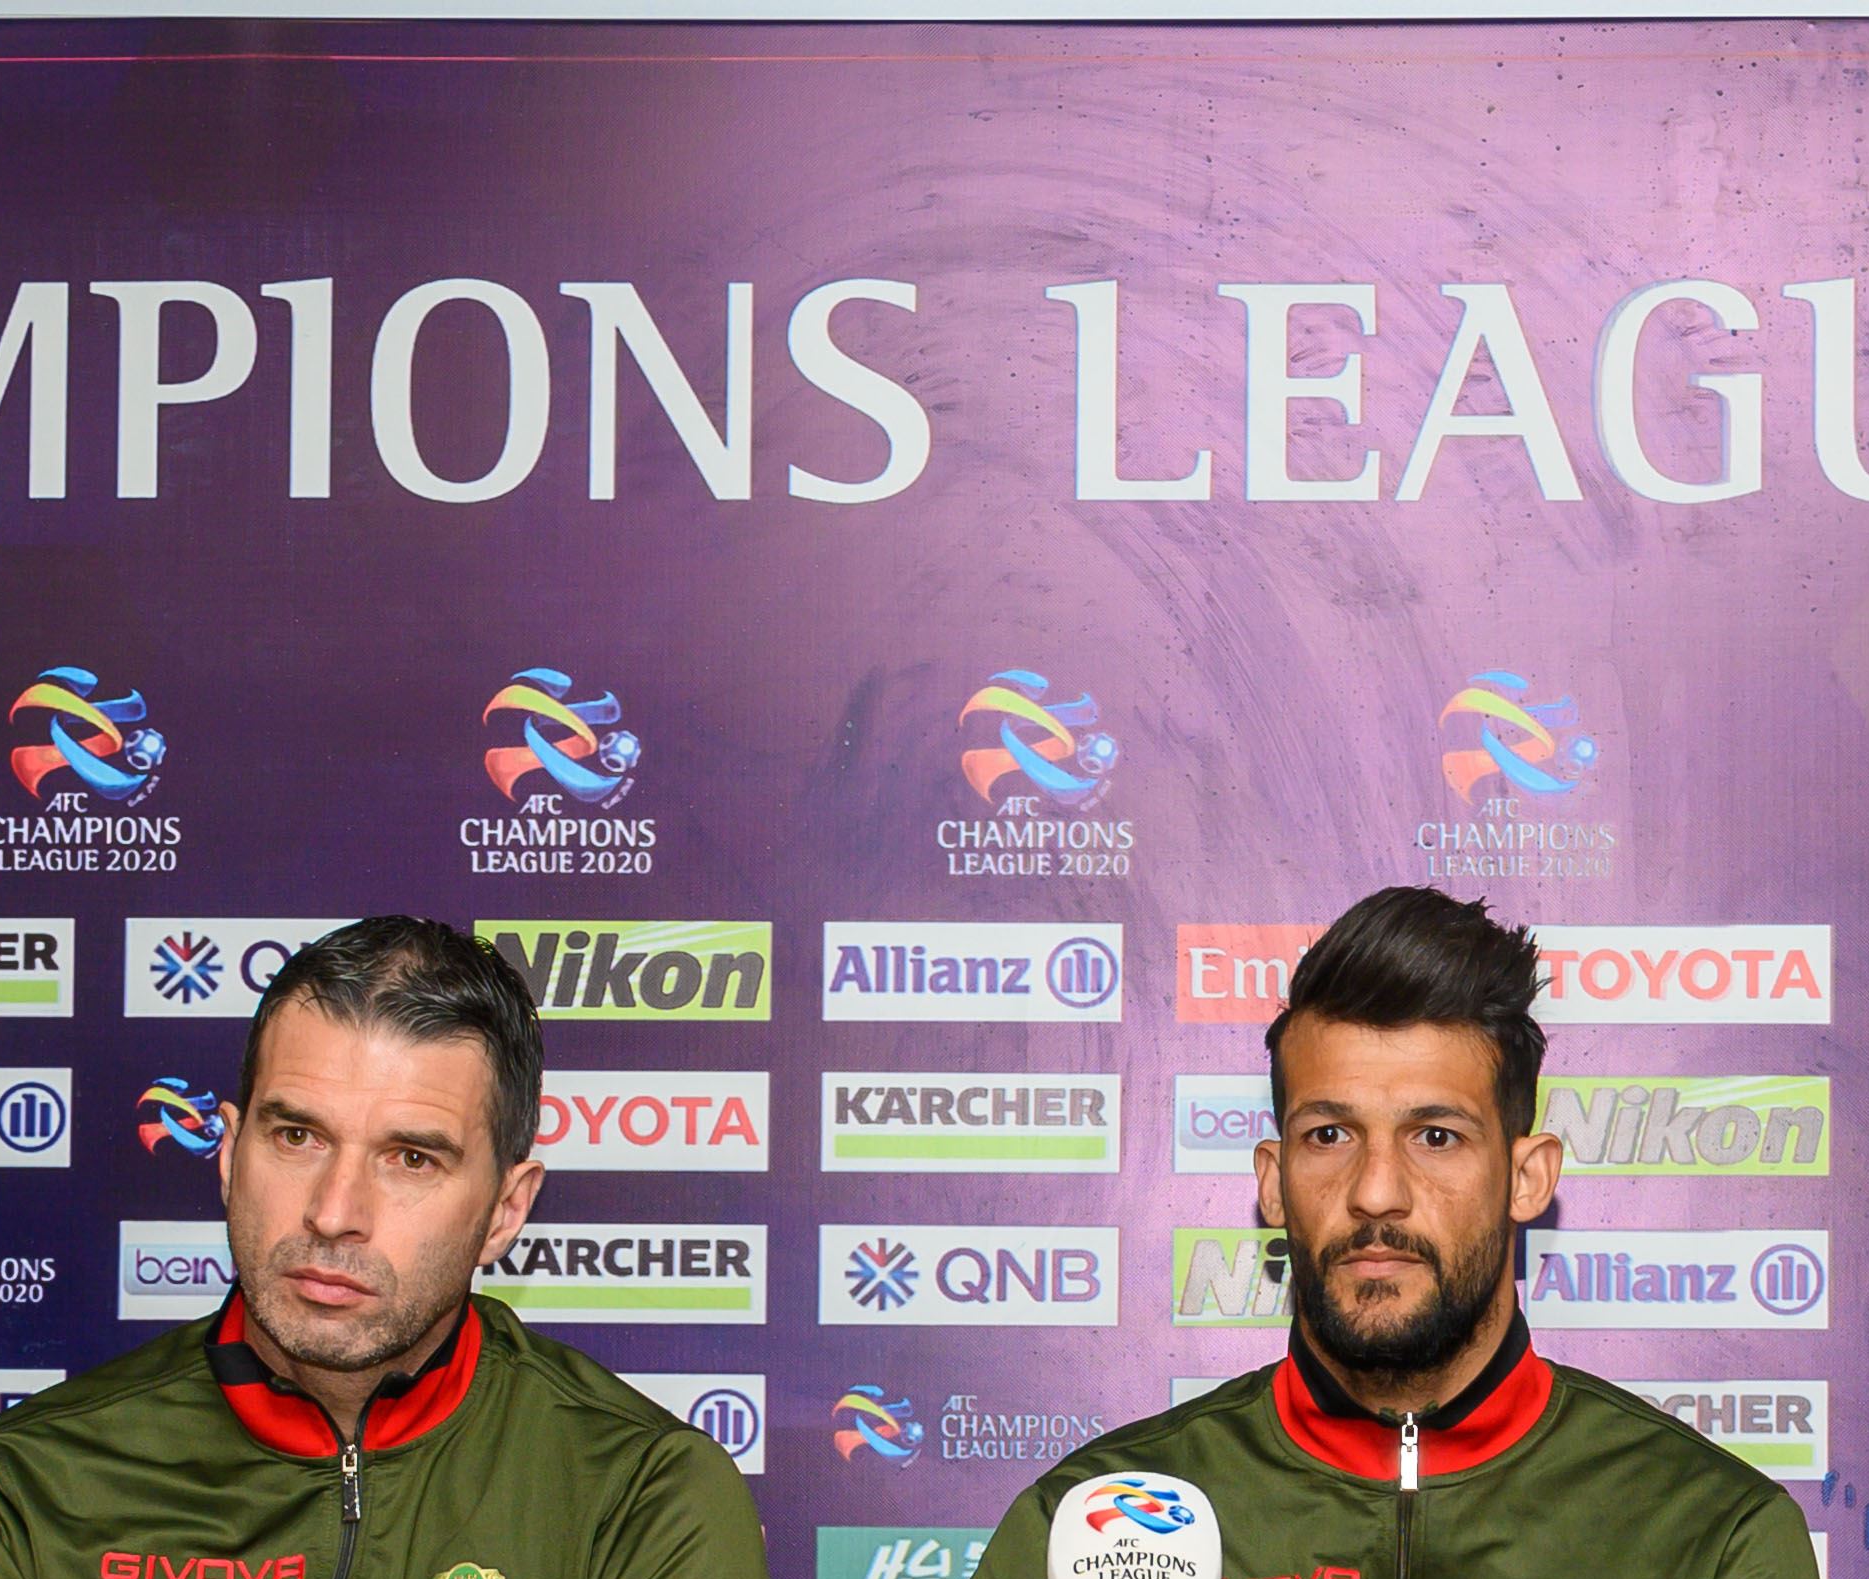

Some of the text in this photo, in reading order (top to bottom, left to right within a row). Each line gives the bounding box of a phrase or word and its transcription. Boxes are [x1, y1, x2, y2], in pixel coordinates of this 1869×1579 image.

[46, 793, 88, 812] AFC
[520, 794, 562, 814] AFC
[997, 796, 1040, 816] AFC
[461, 819, 655, 847] CHAMPIONS
[938, 821, 1134, 849] CHAMPIONS
[1416, 822, 1615, 850] CHAMPIONS
[106, 849, 176, 871] 2020
[471, 851, 651, 873] LEAGUE 2020
[949, 853, 1129, 875] LEAGUE 2020
[1427, 854, 1611, 877] LEAGUE 2020
[829, 946, 1030, 994] Allianz
[1549, 948, 1821, 1000] TOYOTA
[835, 1087, 1106, 1126] KÄRCHER
[534, 1095, 759, 1147] OYOTA
[1545, 1086, 1822, 1167] Nikon
[936, 1248, 1100, 1304] QNB
[1531, 1253, 1736, 1303] Allianz
[941, 1414, 1105, 1439] CHAMPIONS
[942, 1440, 1027, 1460] LEAGUE
[1113, 1538, 1140, 1548] AFC
[1073, 1551, 1196, 1577] CHAMPIONS
